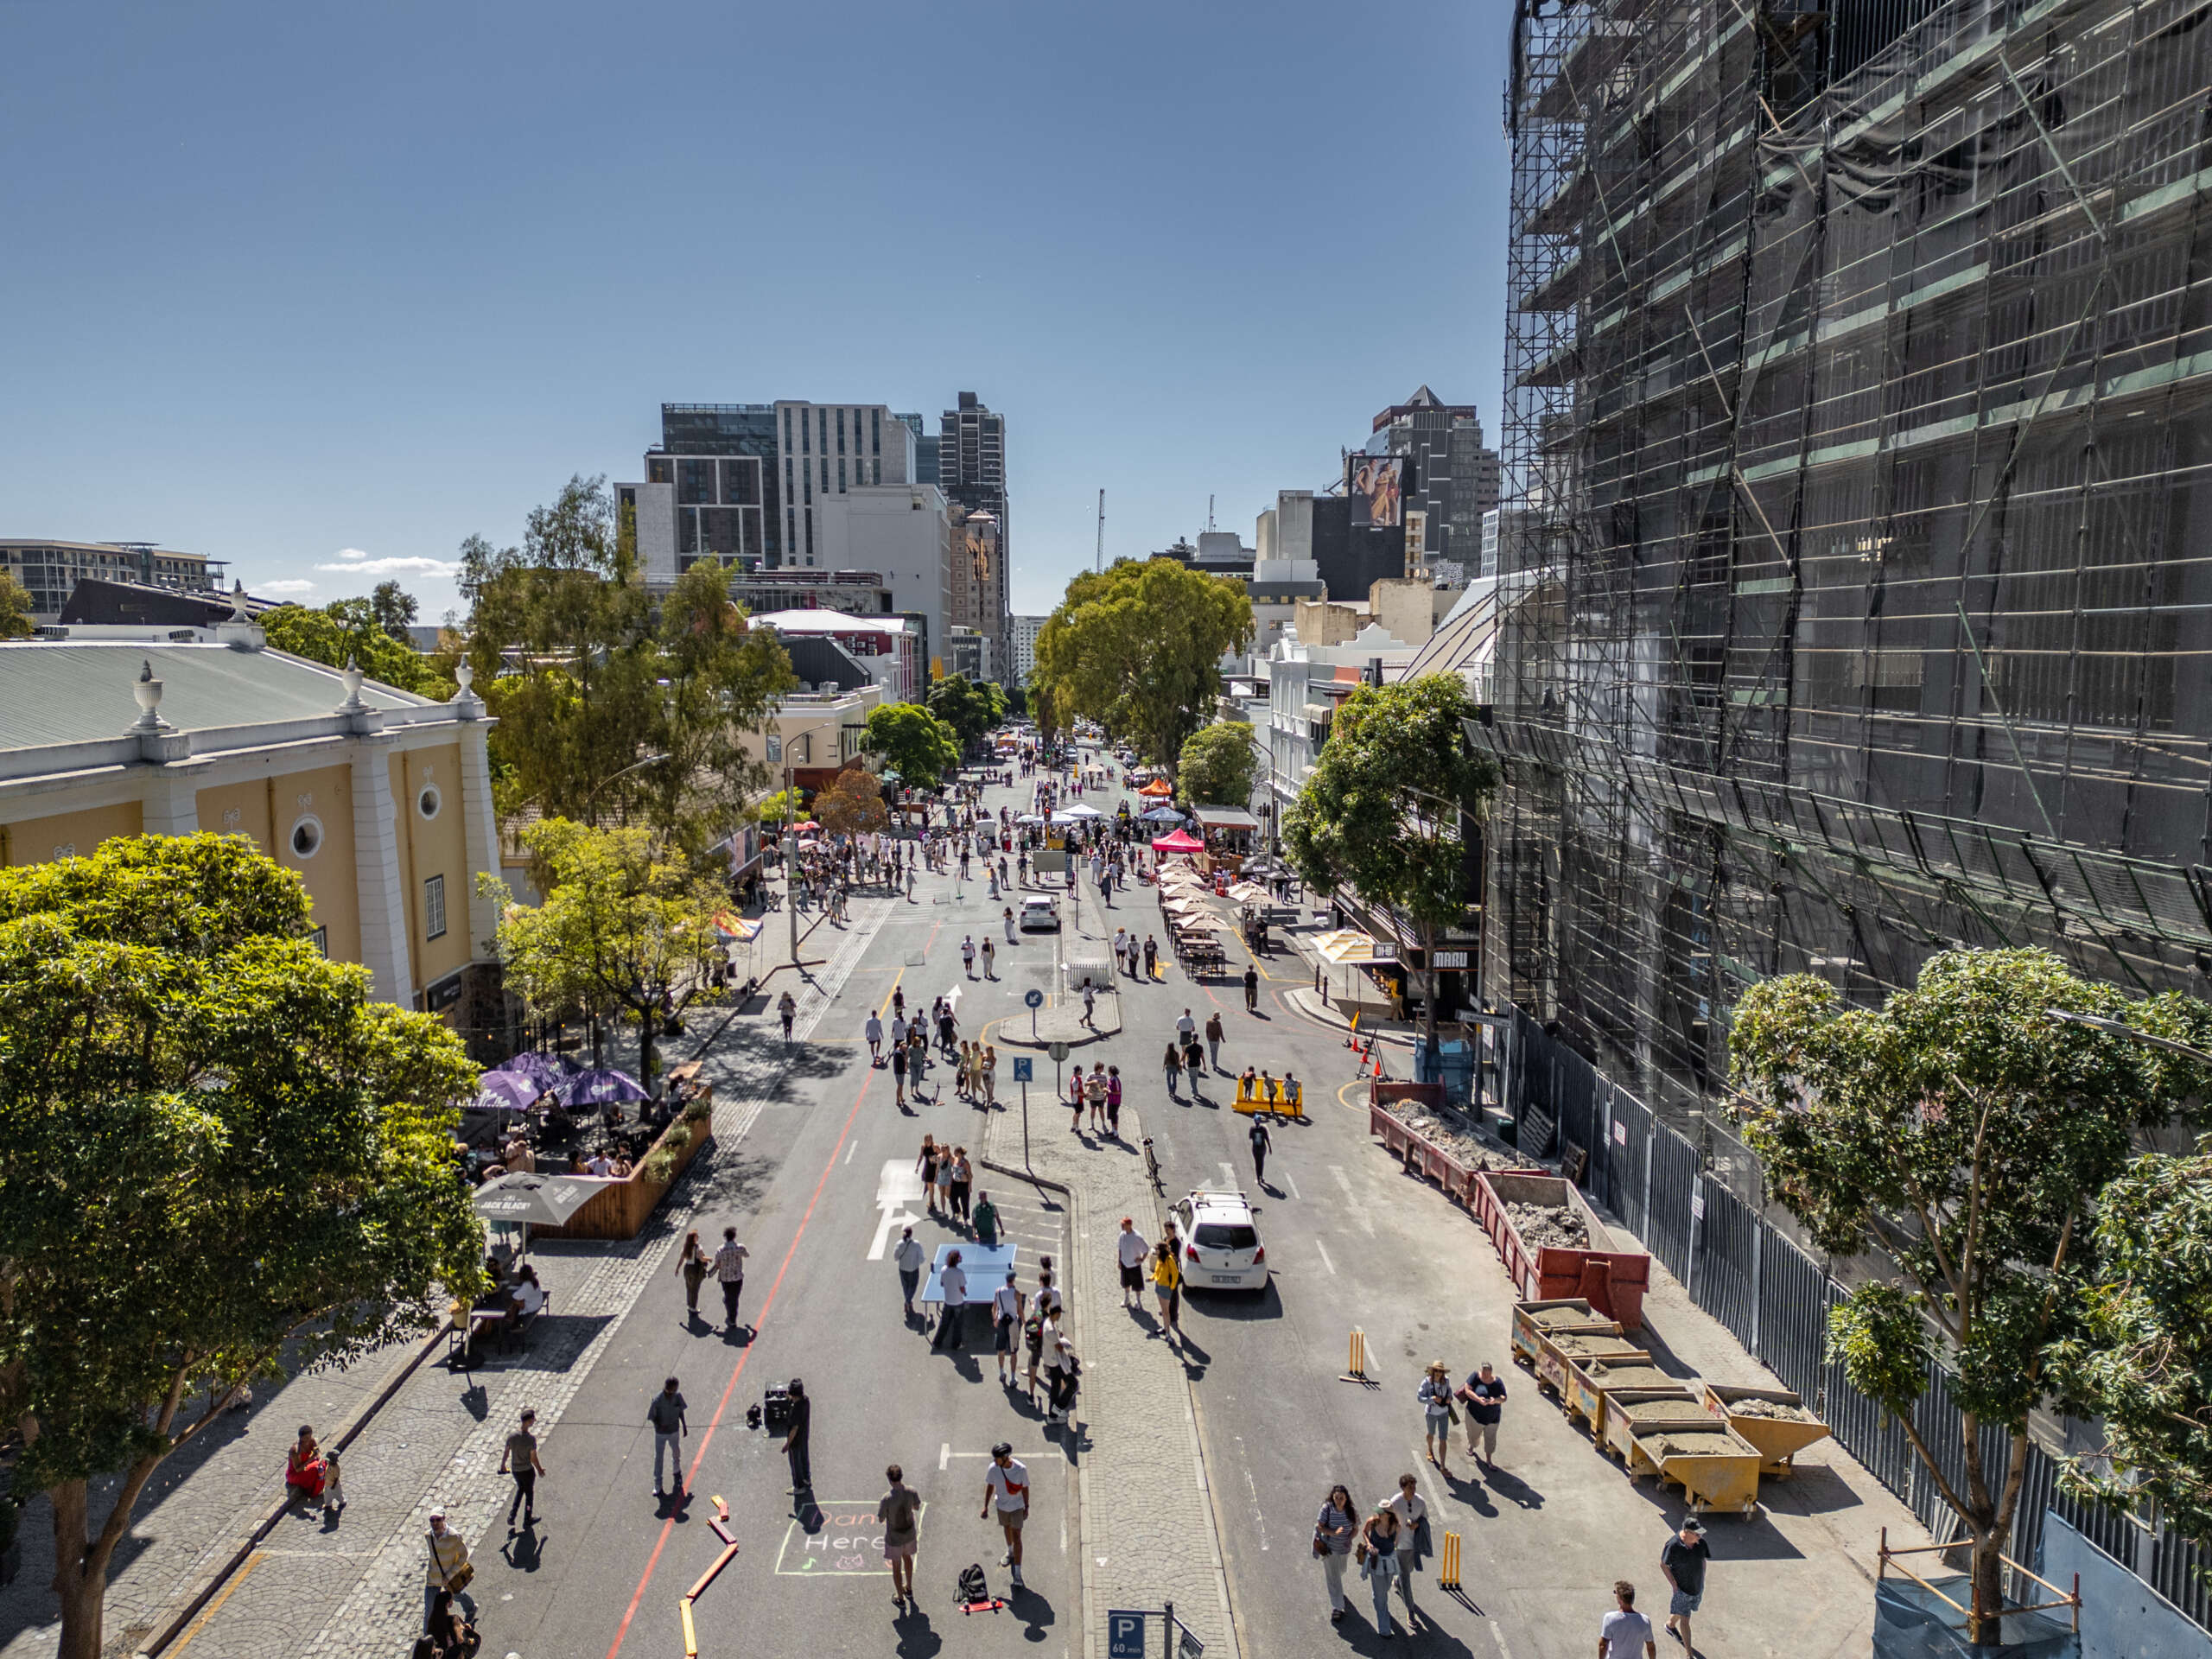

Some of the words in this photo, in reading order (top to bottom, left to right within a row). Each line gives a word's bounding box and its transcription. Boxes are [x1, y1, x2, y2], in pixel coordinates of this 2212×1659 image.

[1433, 952, 1467, 967] MARU
[1019, 1059, 1027, 1069] P
[810, 1510, 876, 1527] Dan
[804, 1534, 885, 1551] Here
[1118, 1619, 1135, 1638] P
[1113, 1643, 1125, 1653] 60
